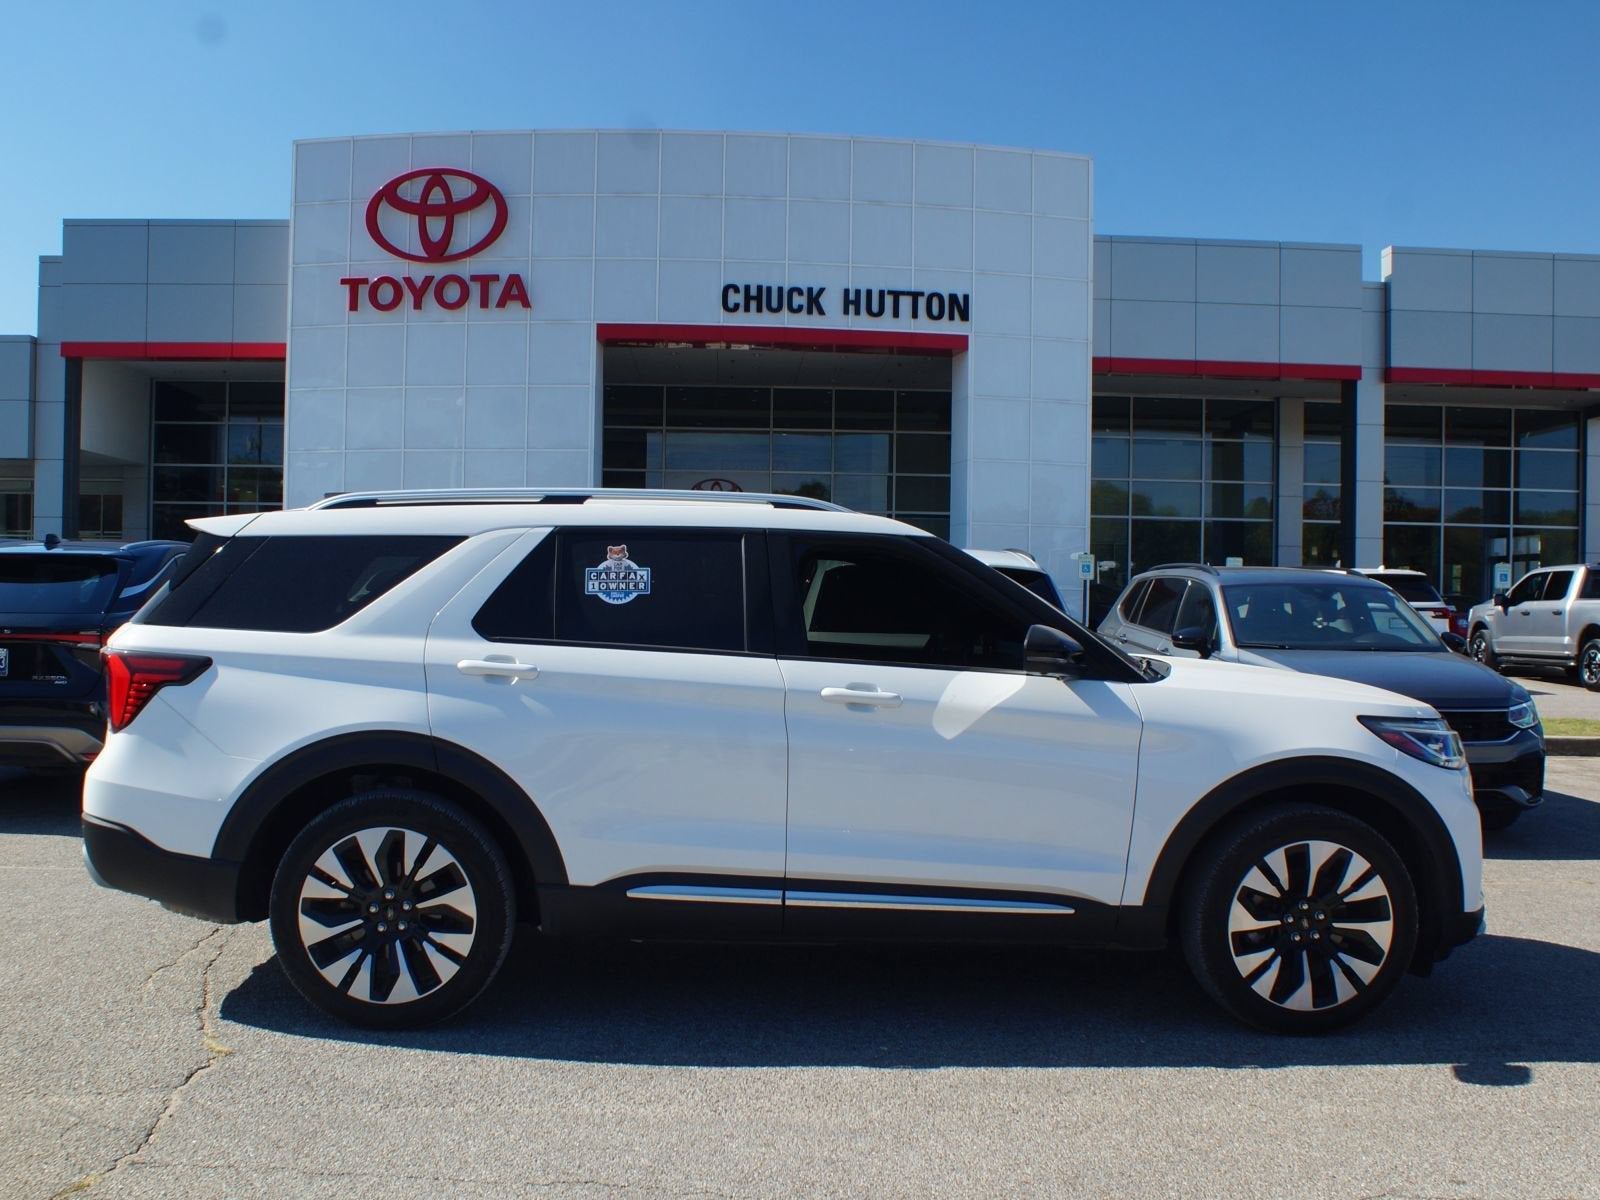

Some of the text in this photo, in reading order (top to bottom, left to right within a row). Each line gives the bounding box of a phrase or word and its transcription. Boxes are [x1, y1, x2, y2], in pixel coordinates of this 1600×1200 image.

[340, 273, 531, 312] TOYOTA
[721, 283, 970, 322] CHUCK HUTTON
[590, 572, 645, 580] CARFAX
